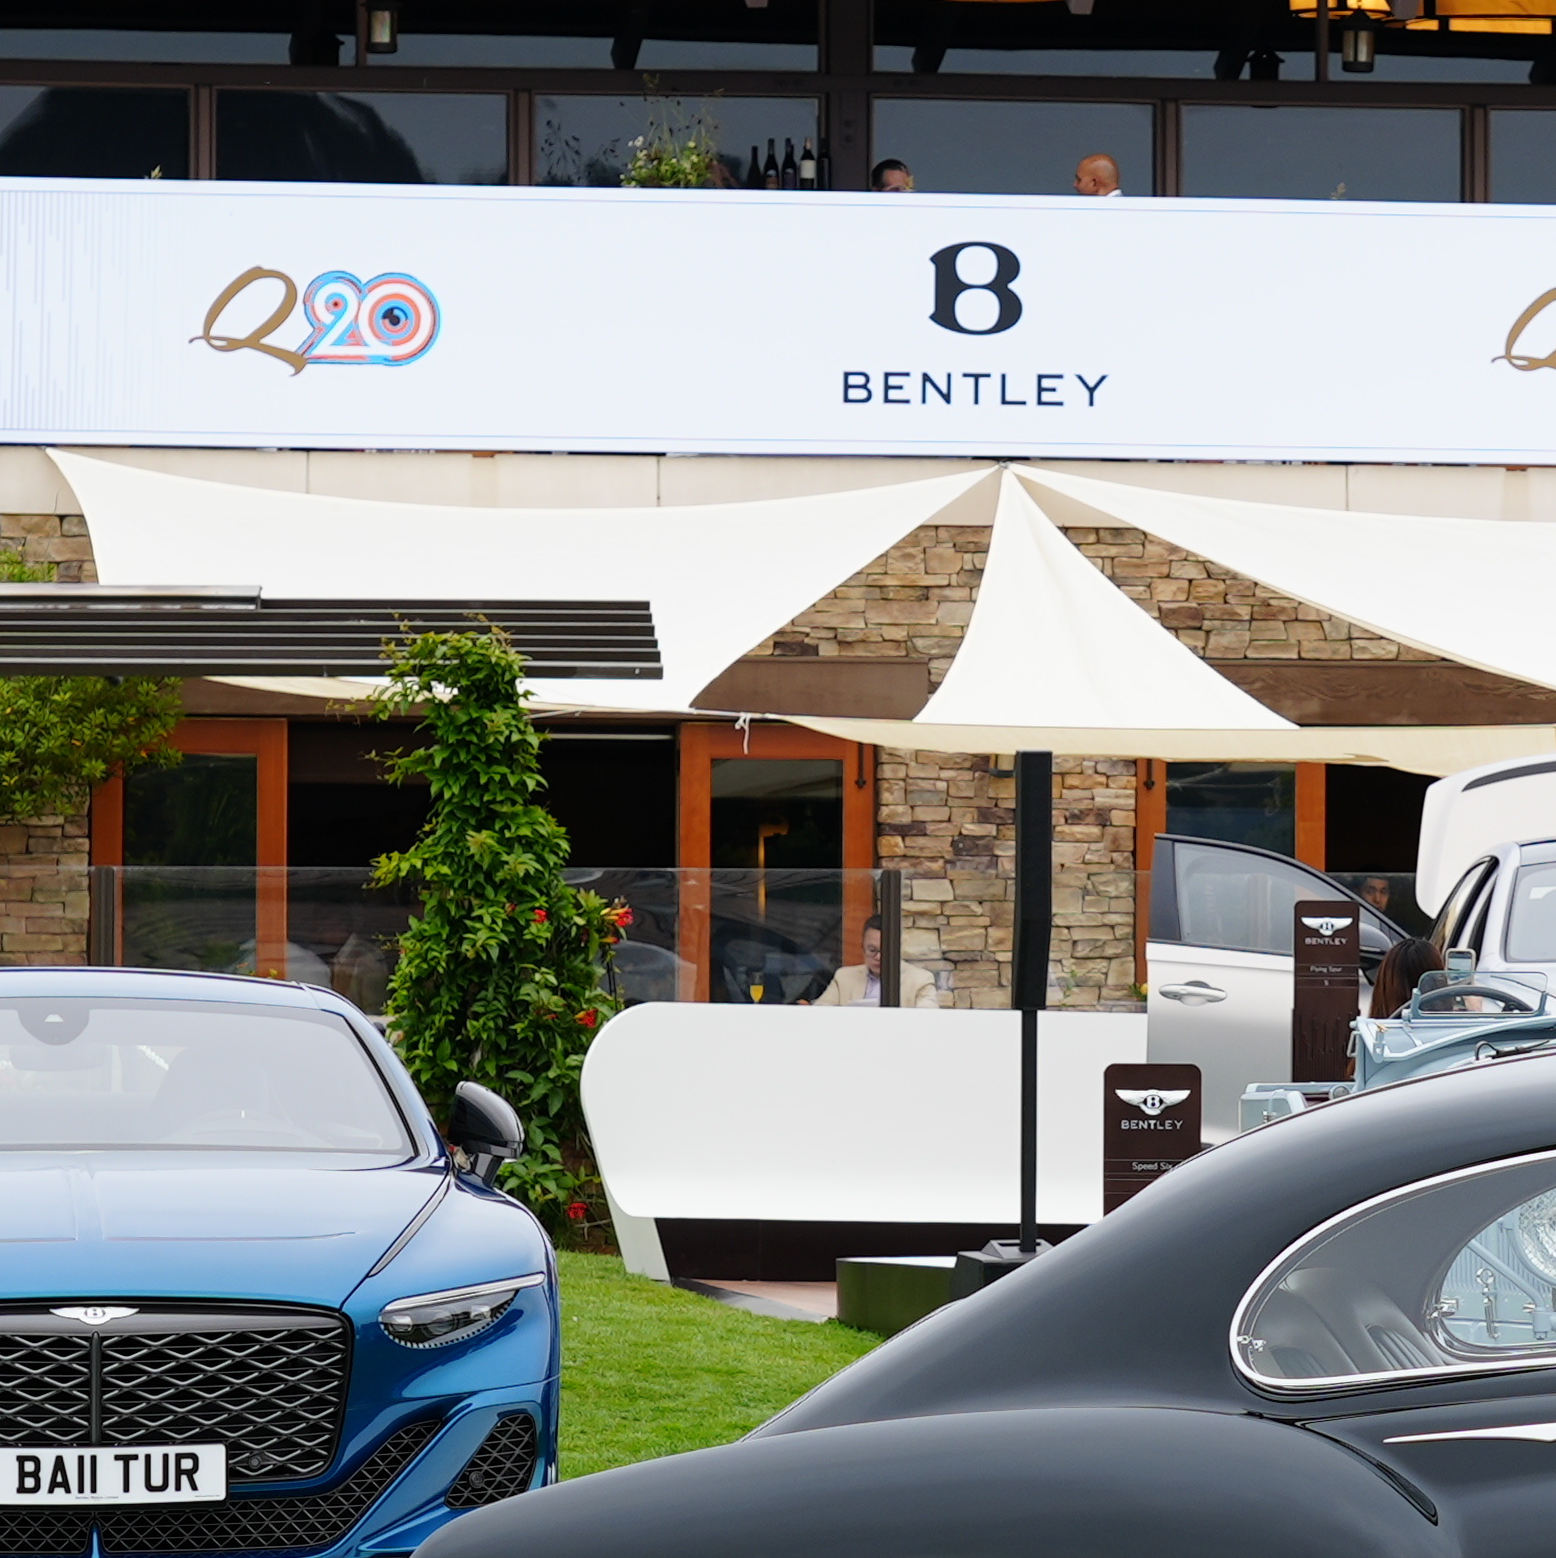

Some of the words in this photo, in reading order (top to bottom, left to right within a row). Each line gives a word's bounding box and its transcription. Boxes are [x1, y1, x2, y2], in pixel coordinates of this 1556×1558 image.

[188, 265, 441, 377] Q20
[842, 371, 1109, 407] BENTLEY
[1304, 937, 1348, 946] BENTLEY
[1121, 1119, 1184, 1130] BENTLEY
[1131, 1161, 1159, 1171] Speed
[114, 1452, 200, 1493] TUR
